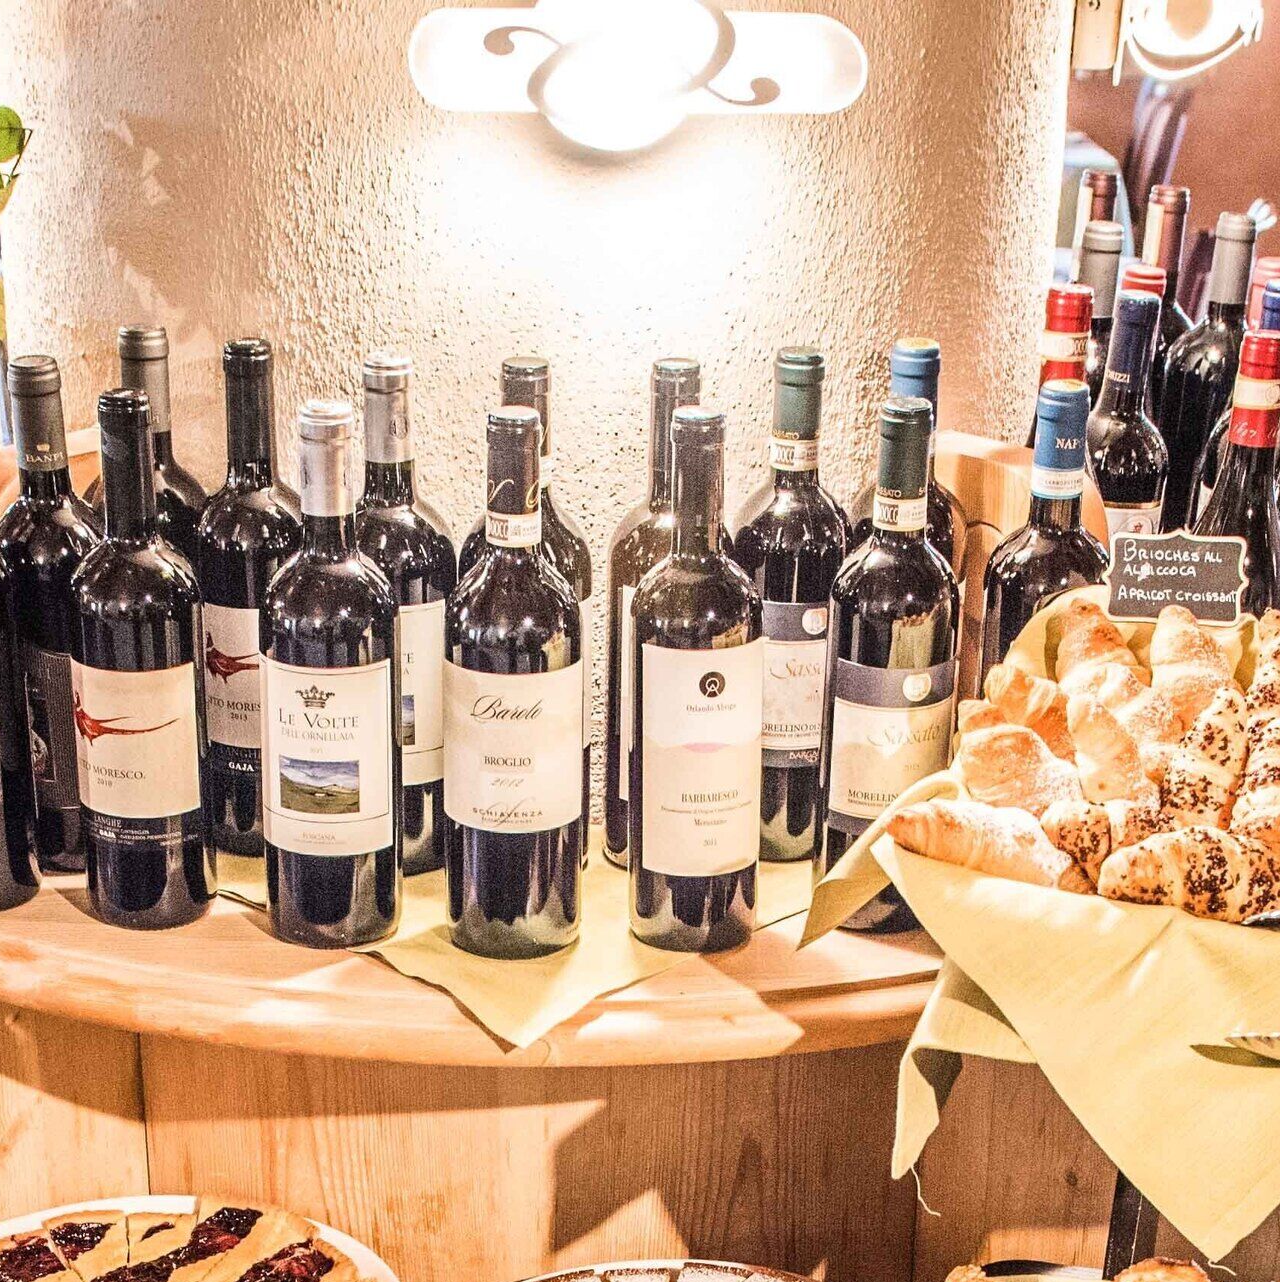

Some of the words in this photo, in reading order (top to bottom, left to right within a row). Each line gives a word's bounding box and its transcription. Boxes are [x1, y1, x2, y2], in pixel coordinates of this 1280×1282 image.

[1204, 551, 1223, 563] ALL
[1117, 584, 1173, 601] APRICOT
[228, 761, 255, 773] GAJA
[484, 755, 532, 768] BROGLIO
[681, 790, 738, 803] BARBARESCO
